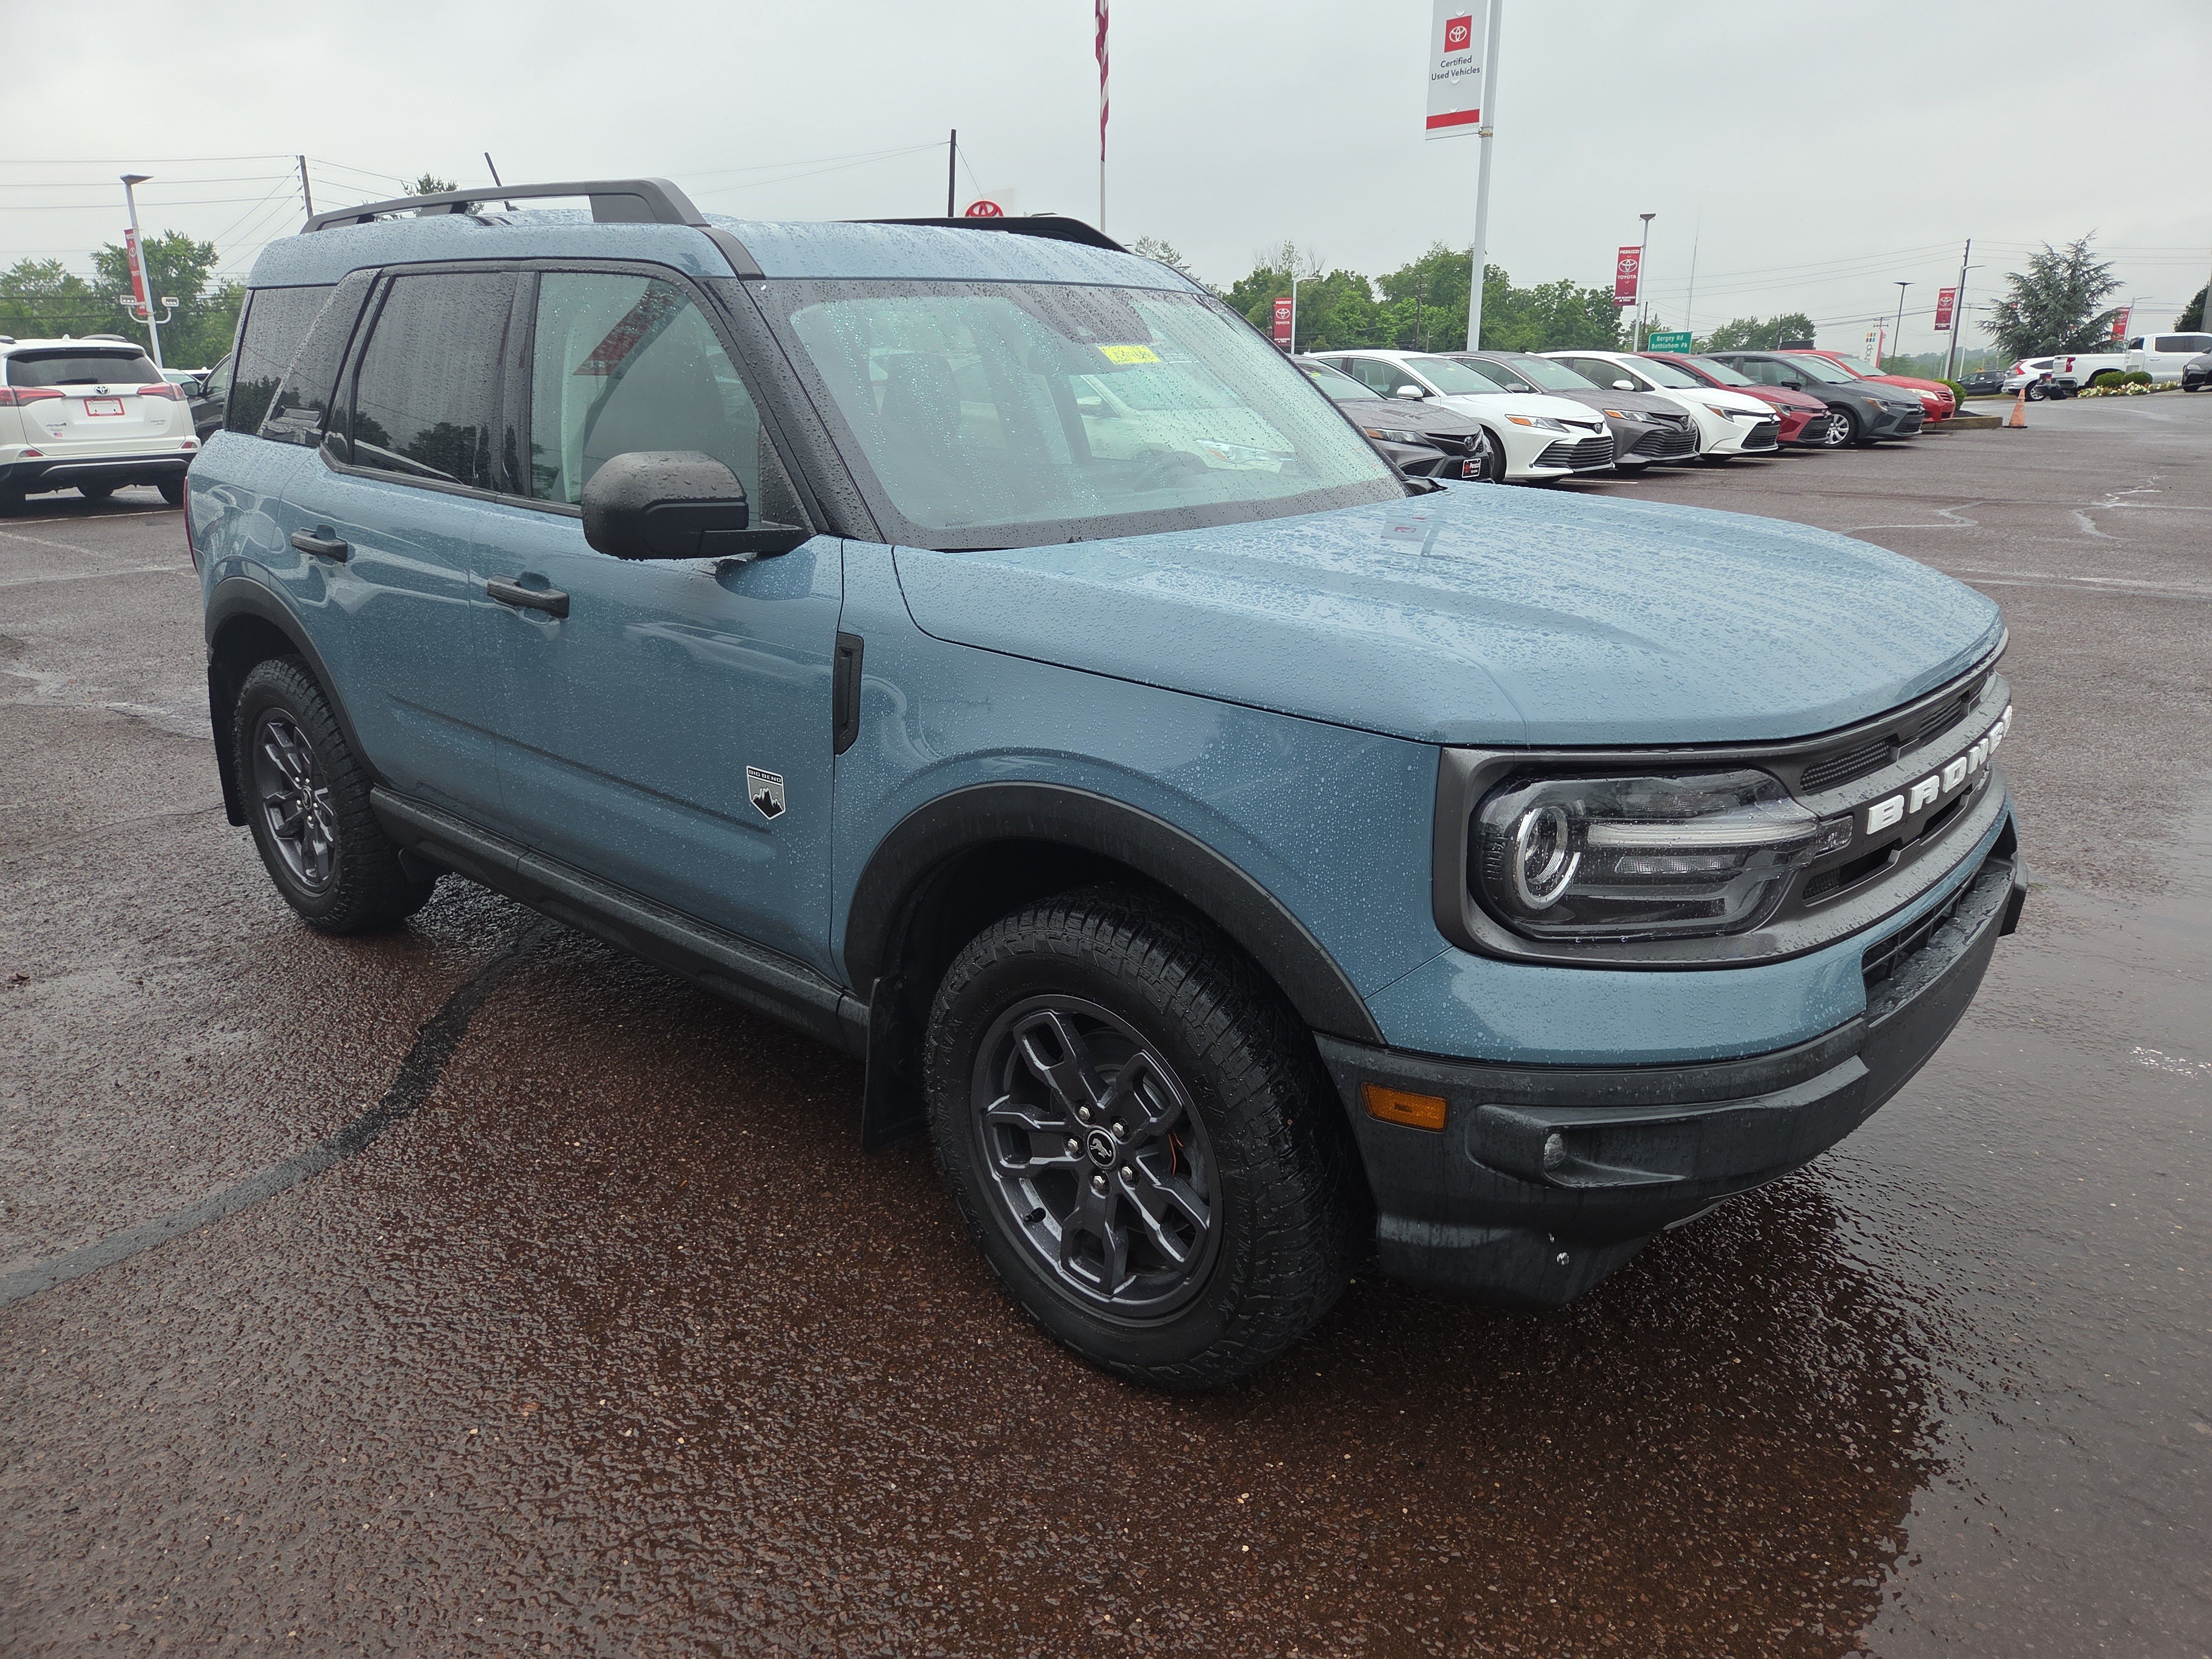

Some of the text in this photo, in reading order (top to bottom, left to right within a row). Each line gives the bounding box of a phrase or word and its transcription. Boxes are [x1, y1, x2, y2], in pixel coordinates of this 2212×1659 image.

[1440, 55, 1472, 68] Certified
[1431, 66, 1480, 81] Used Vehicles
[762, 773, 781, 783] BEND
